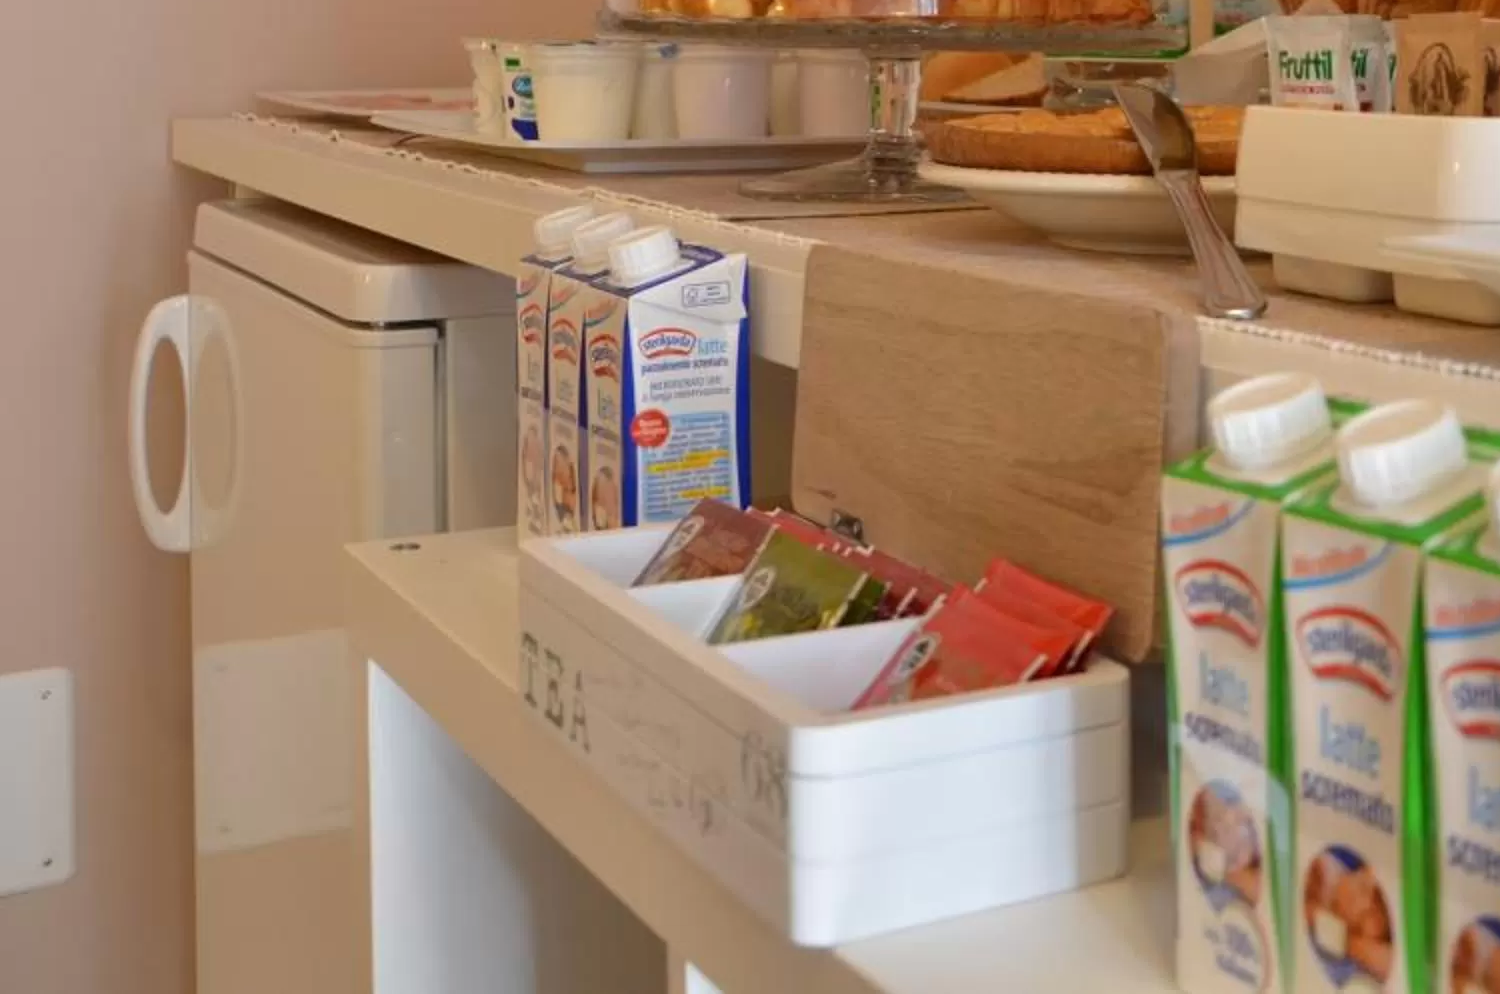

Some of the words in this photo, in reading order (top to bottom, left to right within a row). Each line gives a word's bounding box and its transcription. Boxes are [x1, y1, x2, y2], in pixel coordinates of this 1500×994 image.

[1278, 49, 1333, 80] Fruttil
[522, 630, 591, 754] TEA
[1318, 702, 1381, 778] latte
